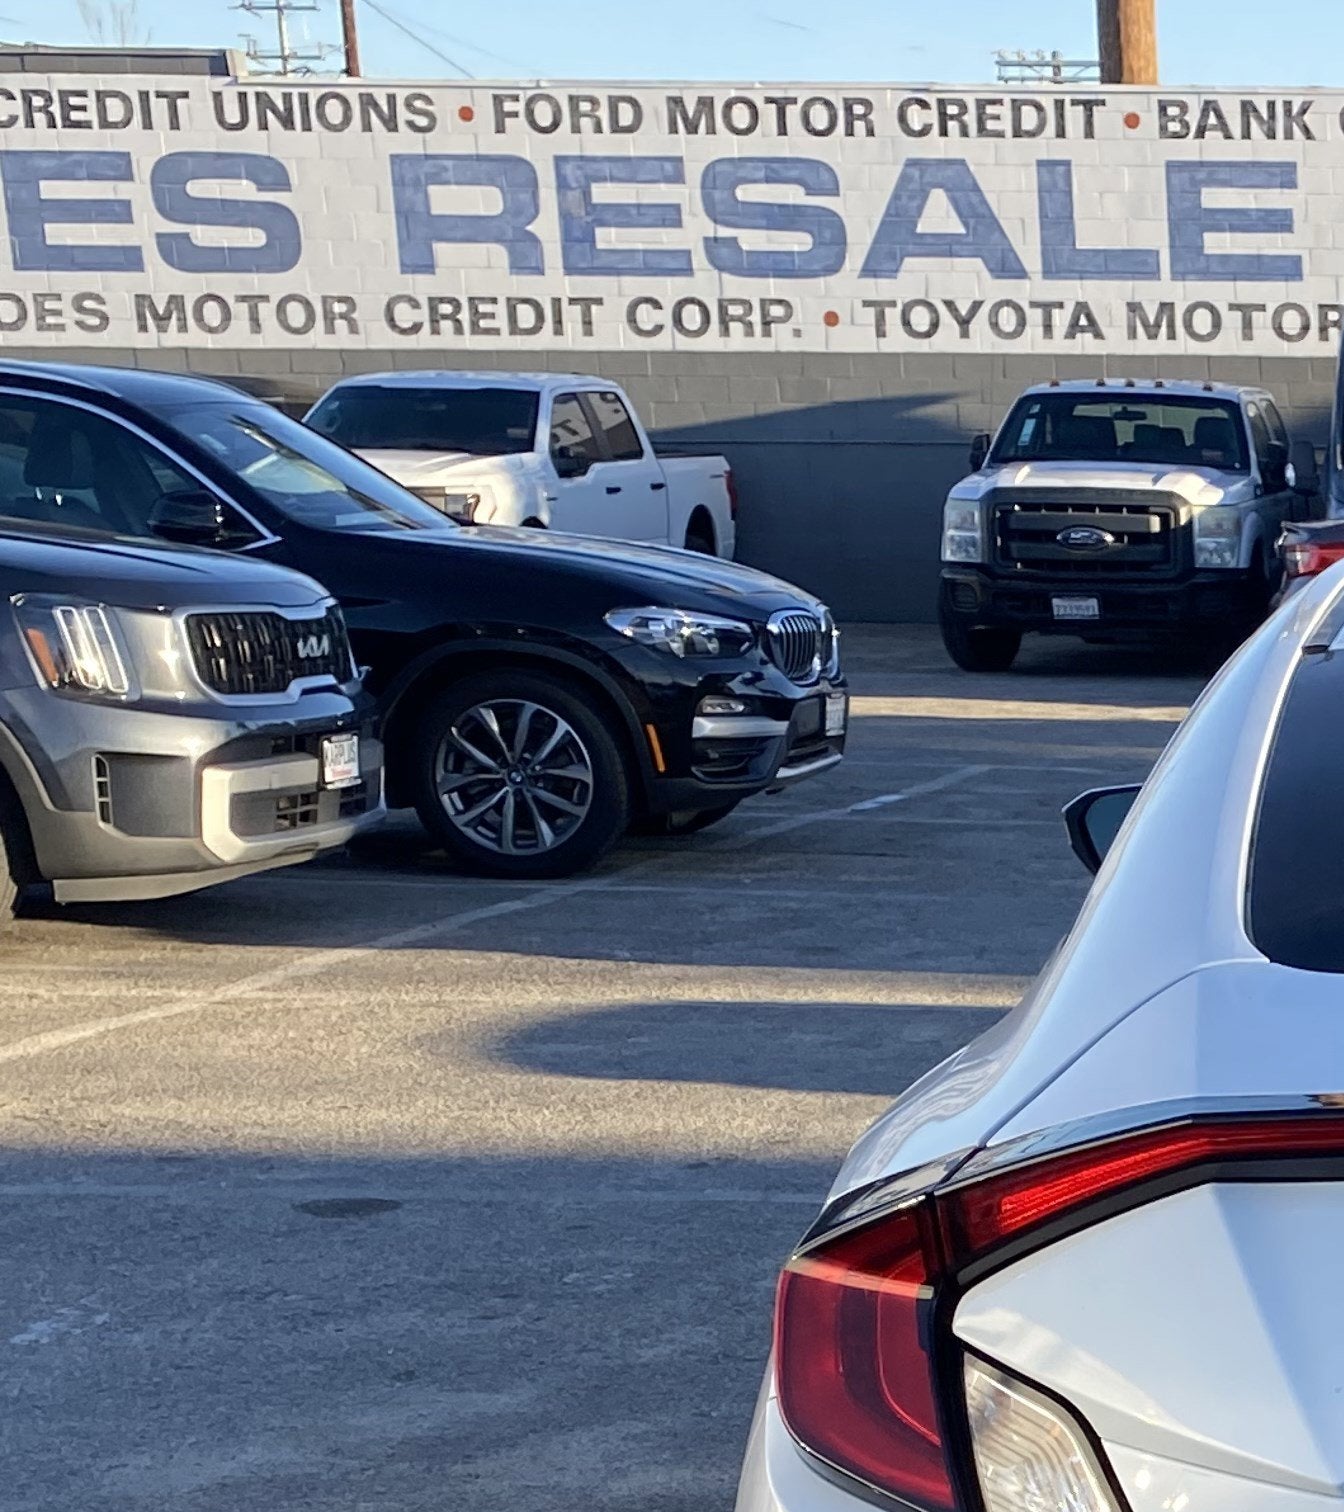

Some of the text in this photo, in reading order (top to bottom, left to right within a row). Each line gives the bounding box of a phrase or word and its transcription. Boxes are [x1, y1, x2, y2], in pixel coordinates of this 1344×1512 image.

[212, 90, 438, 134] UNIONS
[494, 94, 643, 135] FORD
[667, 96, 875, 138] MOTOR
[897, 97, 1106, 139] CREDIT
[1158, 100, 1316, 141] BANK
[390, 153, 1304, 282] RESALE
[134, 294, 359, 336] MOTOR
[384, 296, 604, 338] CREDIT
[626, 297, 802, 338] CORP.
[862, 299, 1105, 340] TOYOTA
